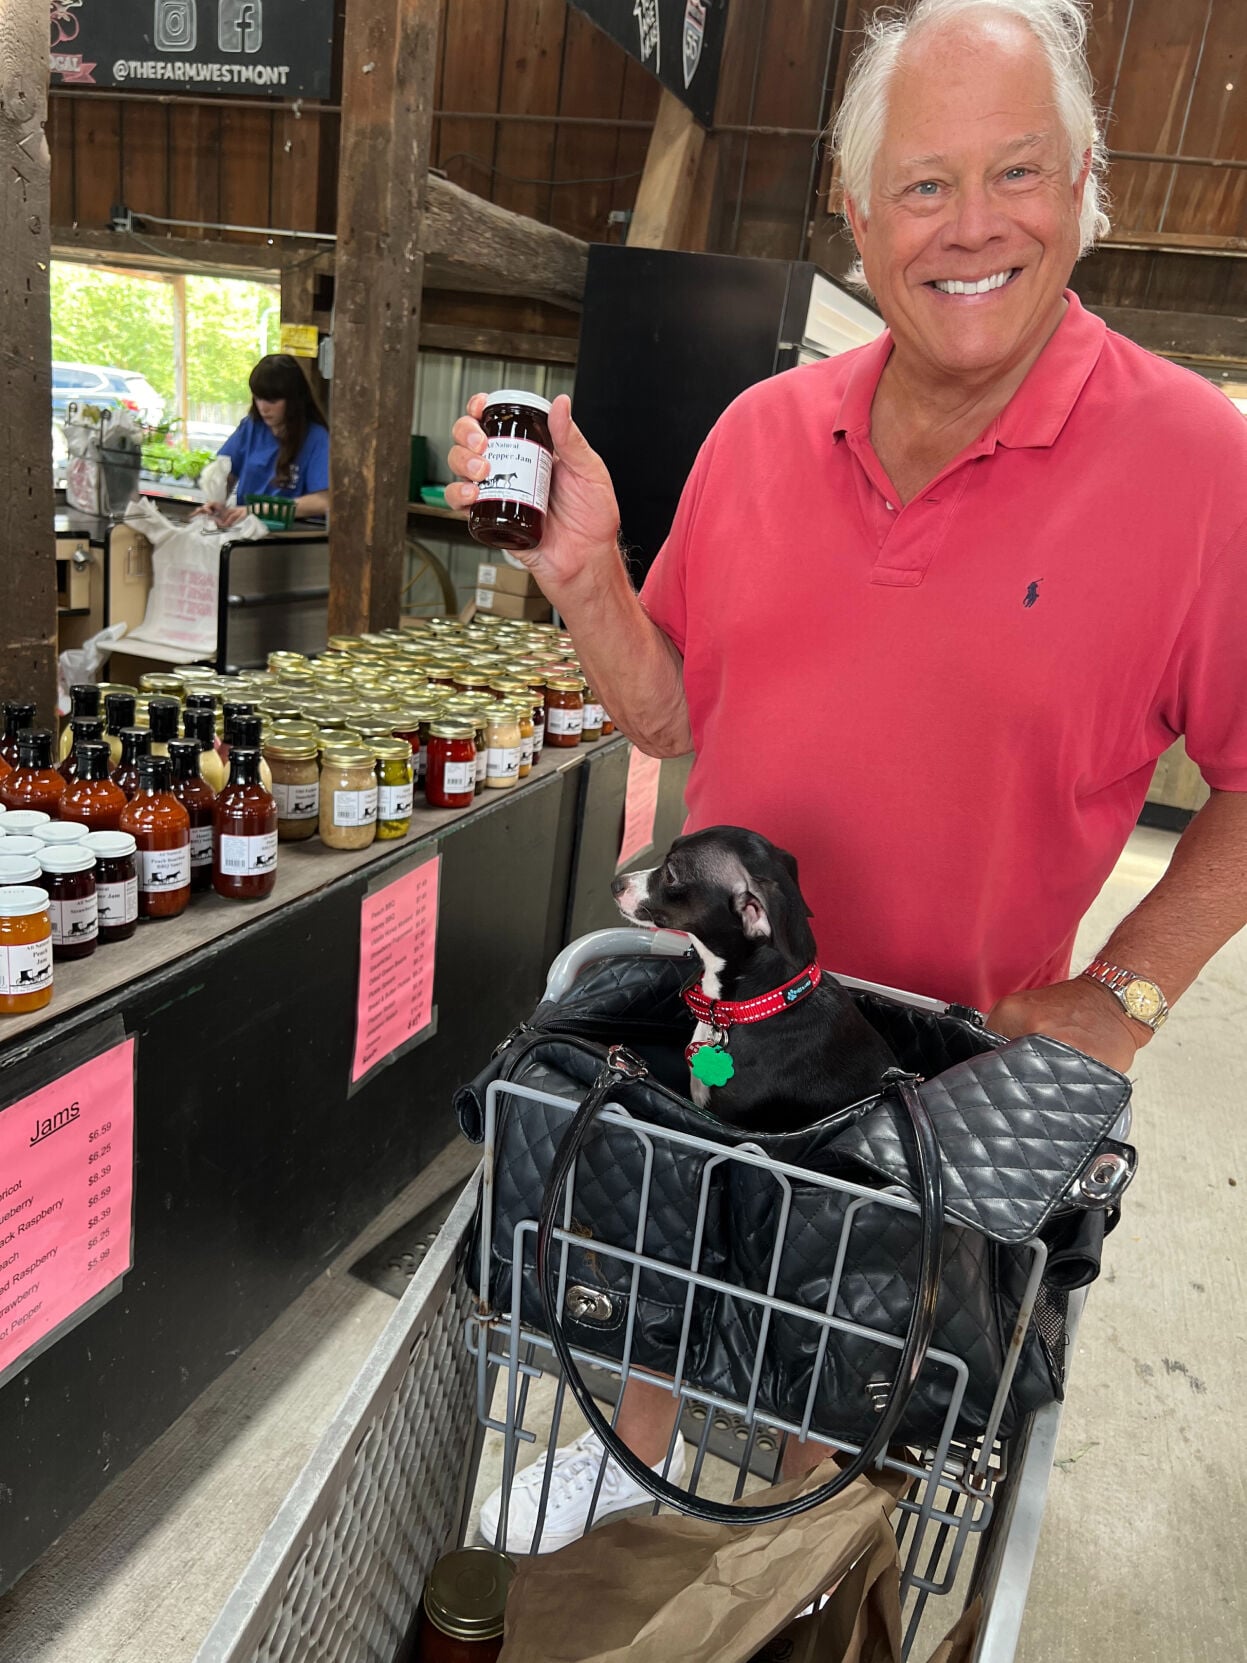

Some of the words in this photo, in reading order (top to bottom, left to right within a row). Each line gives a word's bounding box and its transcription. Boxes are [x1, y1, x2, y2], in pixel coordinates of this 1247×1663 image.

[495, 441, 519, 449] Natural
[488, 452, 514, 461] Pepper
[515, 453, 532, 464] Jam
[30, 1101, 80, 1143] Jams
[88, 1121, 112, 1143] $6.59
[88, 1142, 112, 1165] $6.25
[88, 1186, 111, 1208] $6.59
[17, 1197, 64, 1235] Raspberry
[12, 1245, 58, 1285] Raspberry
[11, 1300, 43, 1332] Pepper
